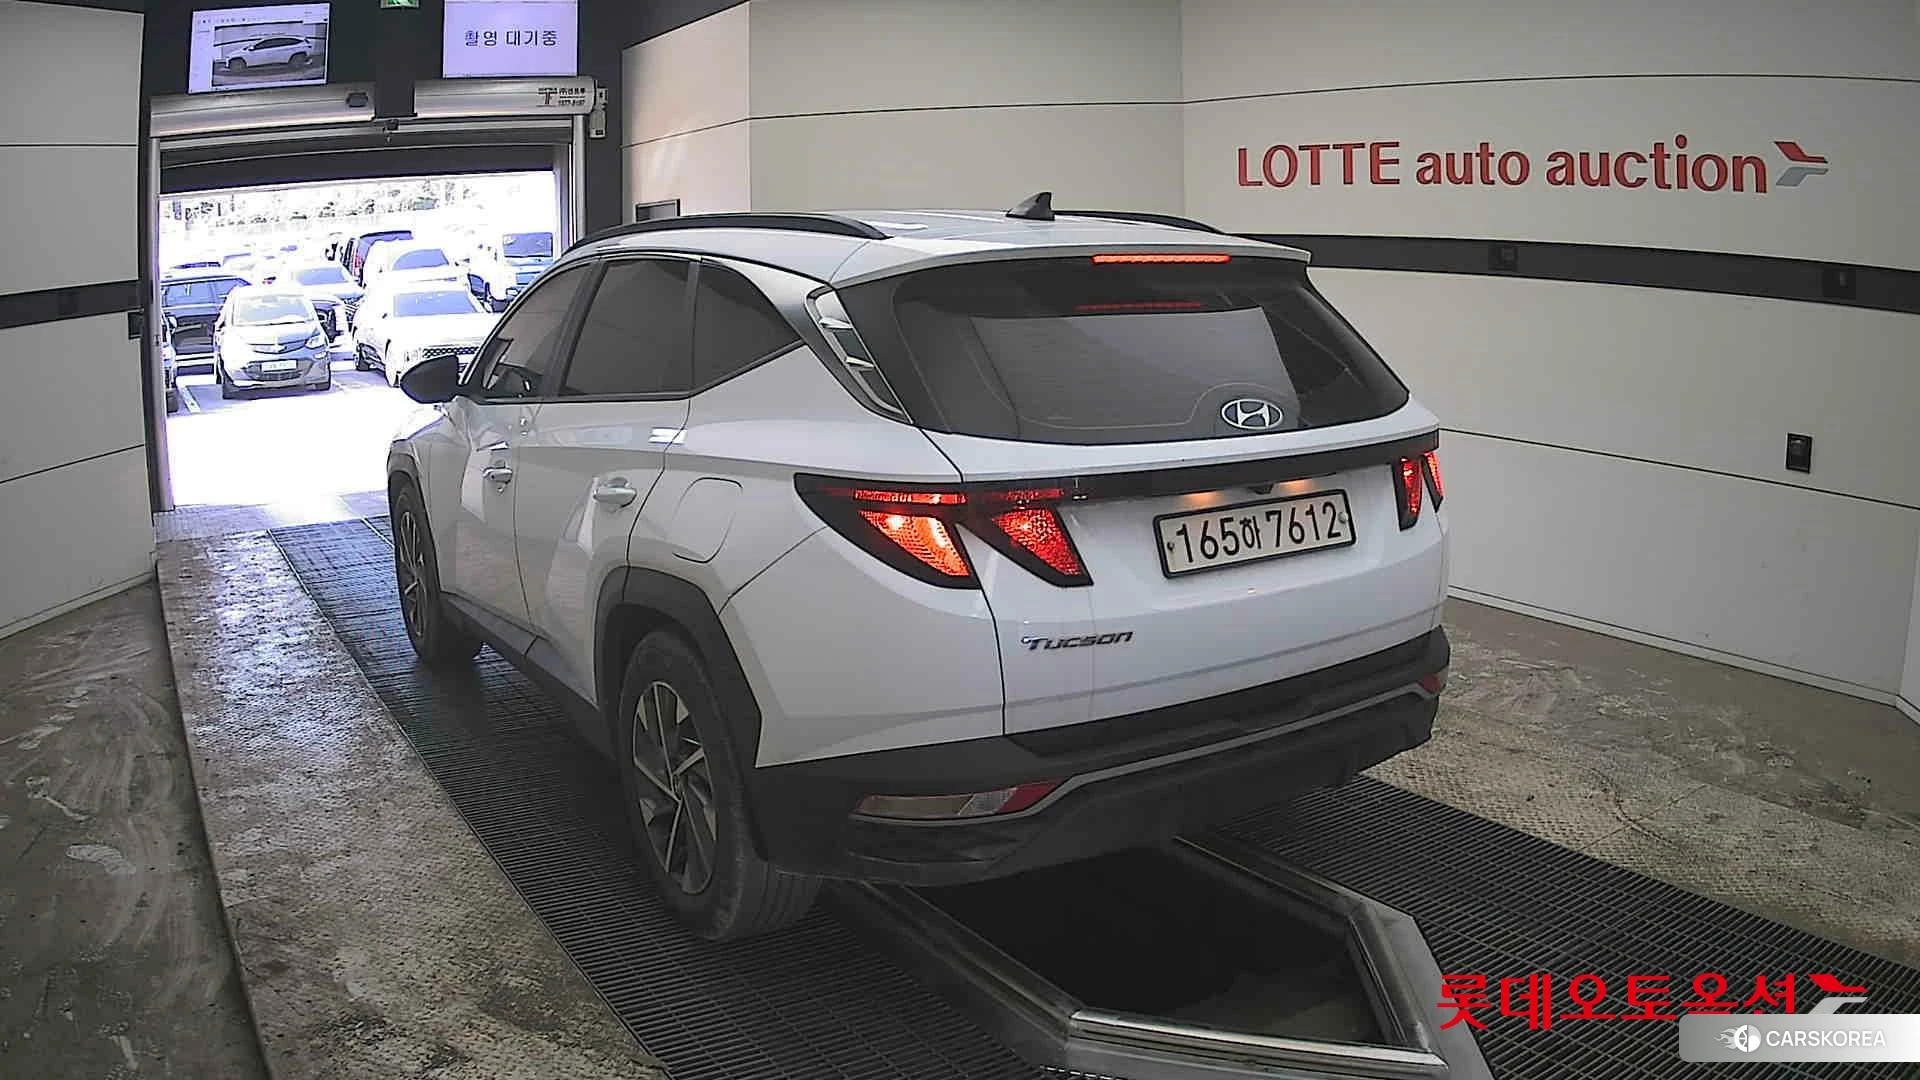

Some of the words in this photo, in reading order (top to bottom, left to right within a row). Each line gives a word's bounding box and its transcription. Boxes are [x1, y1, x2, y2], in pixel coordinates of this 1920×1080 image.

[505, 30, 557, 47] 대기중
[1237, 141, 1401, 187] LOTTE
[1416, 142, 1531, 186] auto
[1545, 134, 1768, 193] auction
